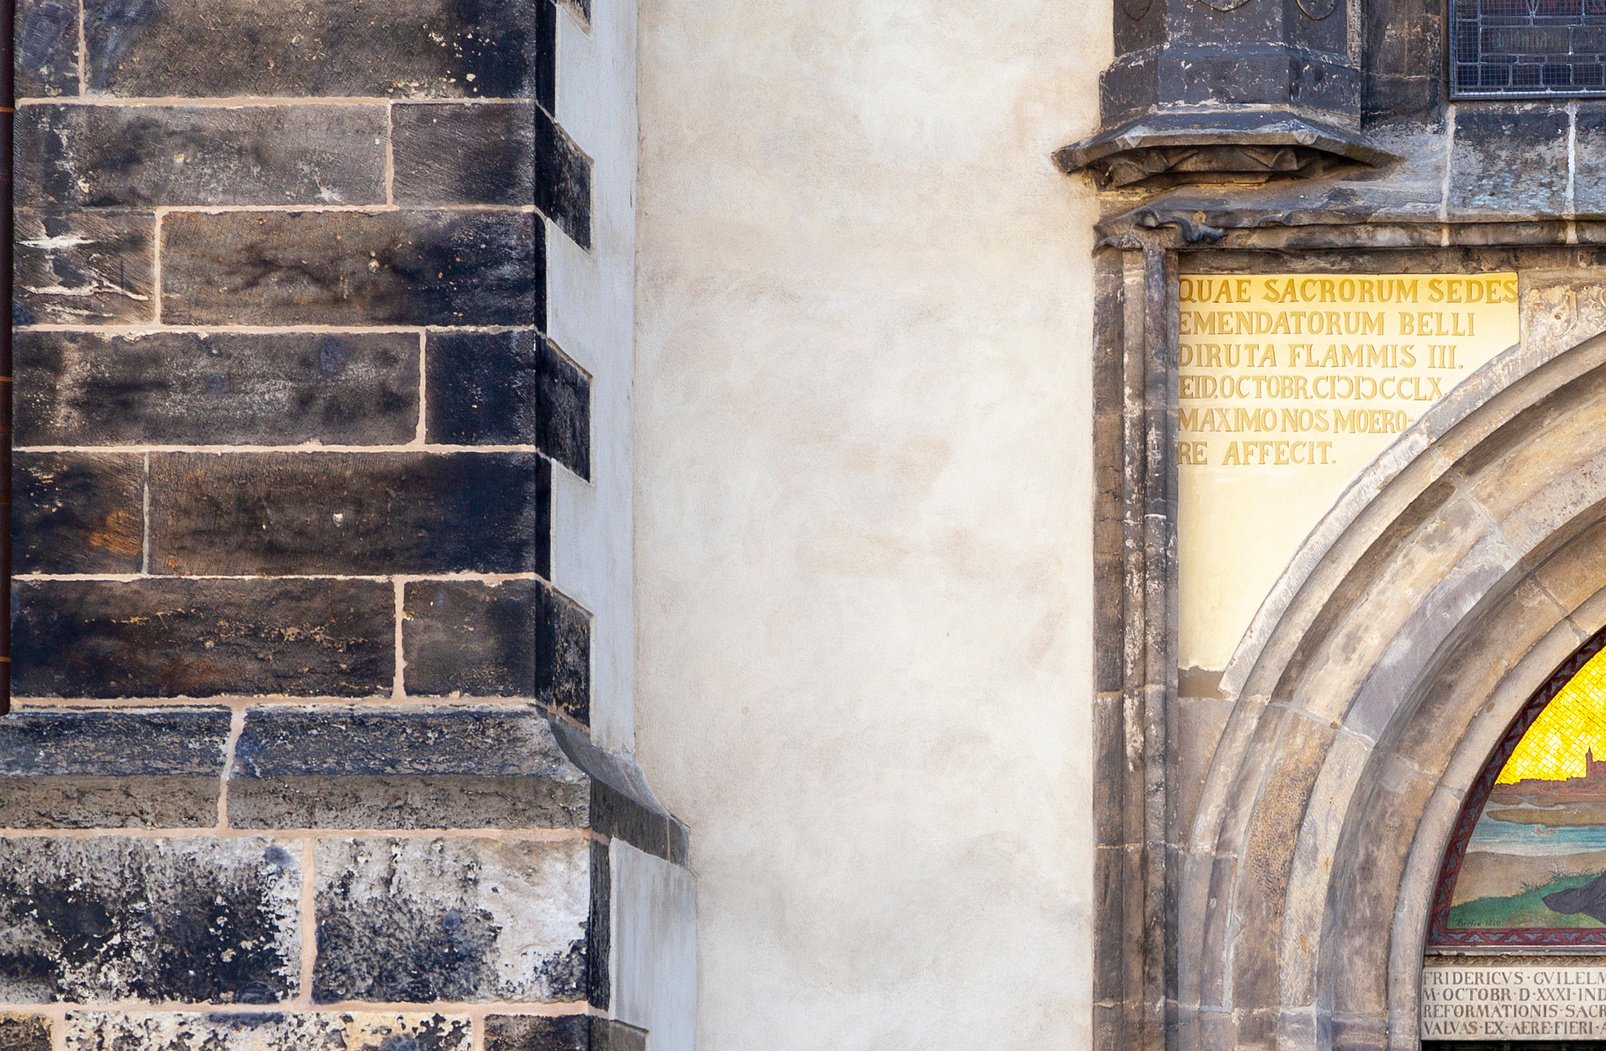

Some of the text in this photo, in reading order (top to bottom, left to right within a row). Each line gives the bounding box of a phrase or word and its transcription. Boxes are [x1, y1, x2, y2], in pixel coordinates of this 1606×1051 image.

[1179, 278, 1518, 304] QUAE SACRORUM SEDES
[1179, 311, 1475, 336] EMENDATORUM BELLI
[1179, 343, 1464, 369] DIRUTA FLAMMIS III.
[1178, 408, 1414, 434] MAXIMO NOS MOERO-
[1177, 441, 1336, 465] RE AFFECIT.
[1422, 971, 1524, 985] FRIDERICVS
[1442, 988, 1511, 1001] OCTOBR
[1536, 988, 1570, 1001] XXXI
[1423, 1004, 1558, 1018] REFORMATIONIS
[1423, 1021, 1478, 1035] VALVAS
[1510, 1021, 1551, 1035] AERE
[1554, 1021, 1593, 1035] FIERI
